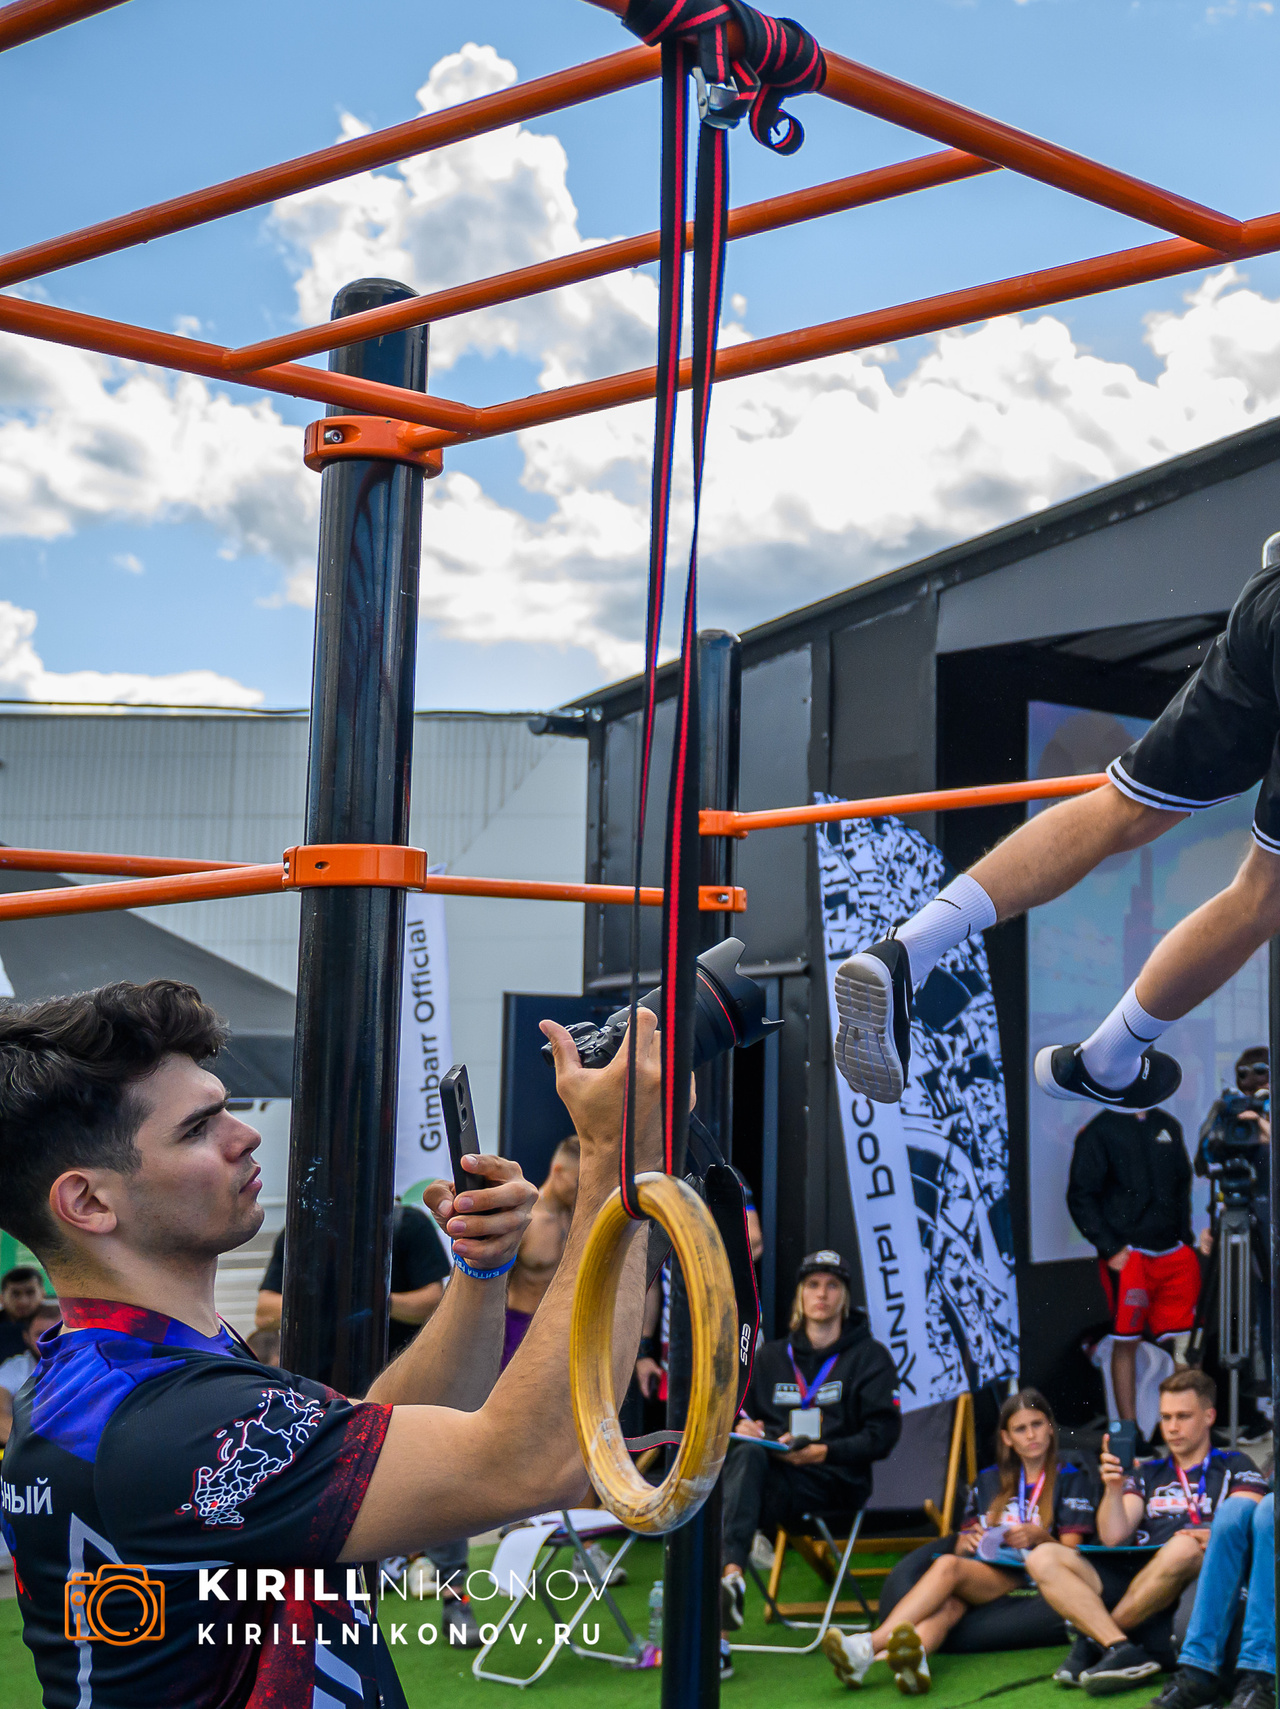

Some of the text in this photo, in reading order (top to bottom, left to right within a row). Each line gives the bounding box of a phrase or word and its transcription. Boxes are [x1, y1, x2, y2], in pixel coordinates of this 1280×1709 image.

[408, 918, 443, 1152] Gimbarr Official
[740, 1323, 752, 1366] EOS
